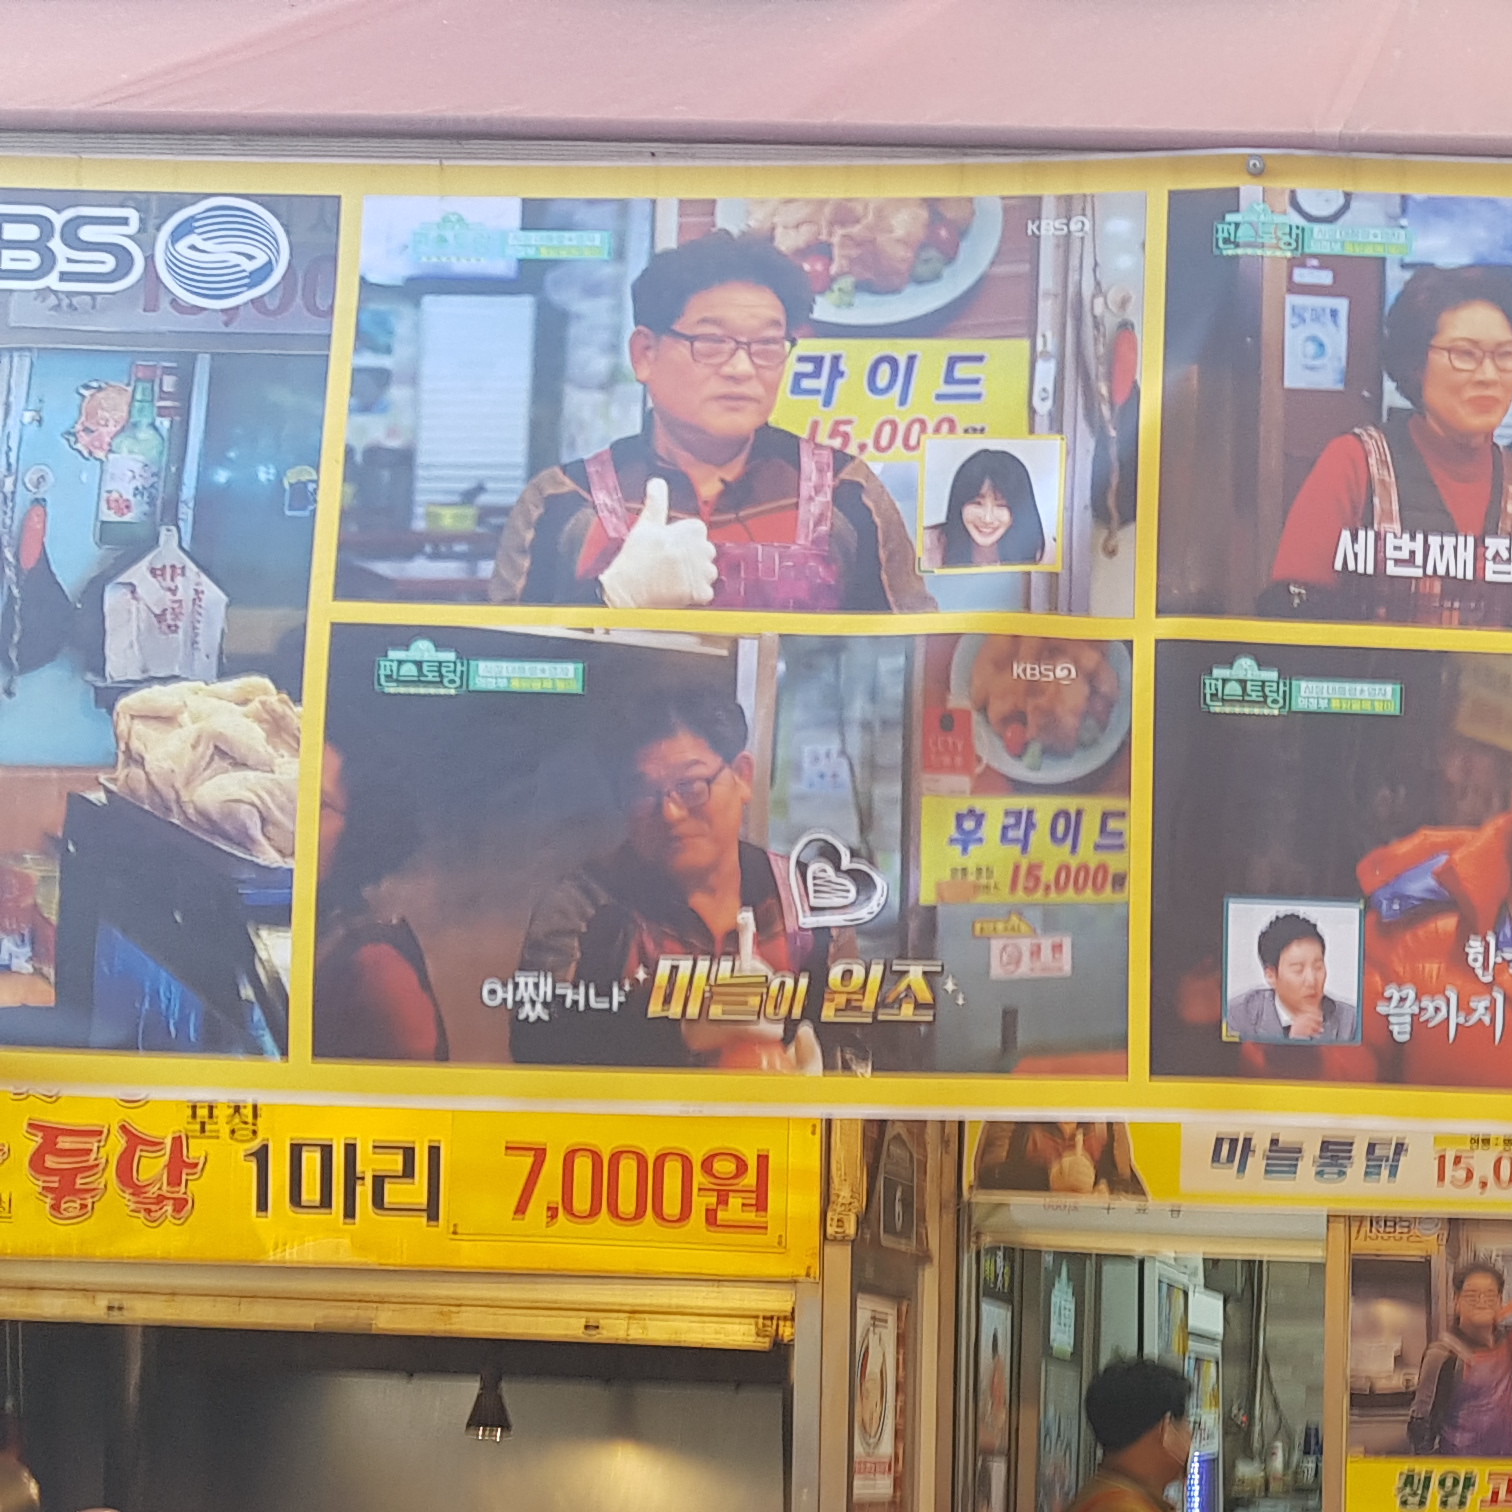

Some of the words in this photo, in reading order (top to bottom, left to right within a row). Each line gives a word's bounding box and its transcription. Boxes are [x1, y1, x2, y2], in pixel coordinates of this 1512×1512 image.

[789, 352, 986, 408] 라이드
[1333, 527, 1375, 576] 세
[1385, 530, 1474, 580] 번째
[1203, 678, 1289, 709] 편스토랑
[948, 805, 1127, 857] 후라이드
[481, 970, 627, 1023] 어쨌거나
[820, 958, 944, 1023] 원조
[185, 1099, 262, 1142] 포장
[23, 1115, 206, 1228] 통닭
[241, 1135, 442, 1228] 1마리
[502, 1140, 770, 1235] 7,000원
[1210, 1130, 1409, 1183] 마늘통닭
